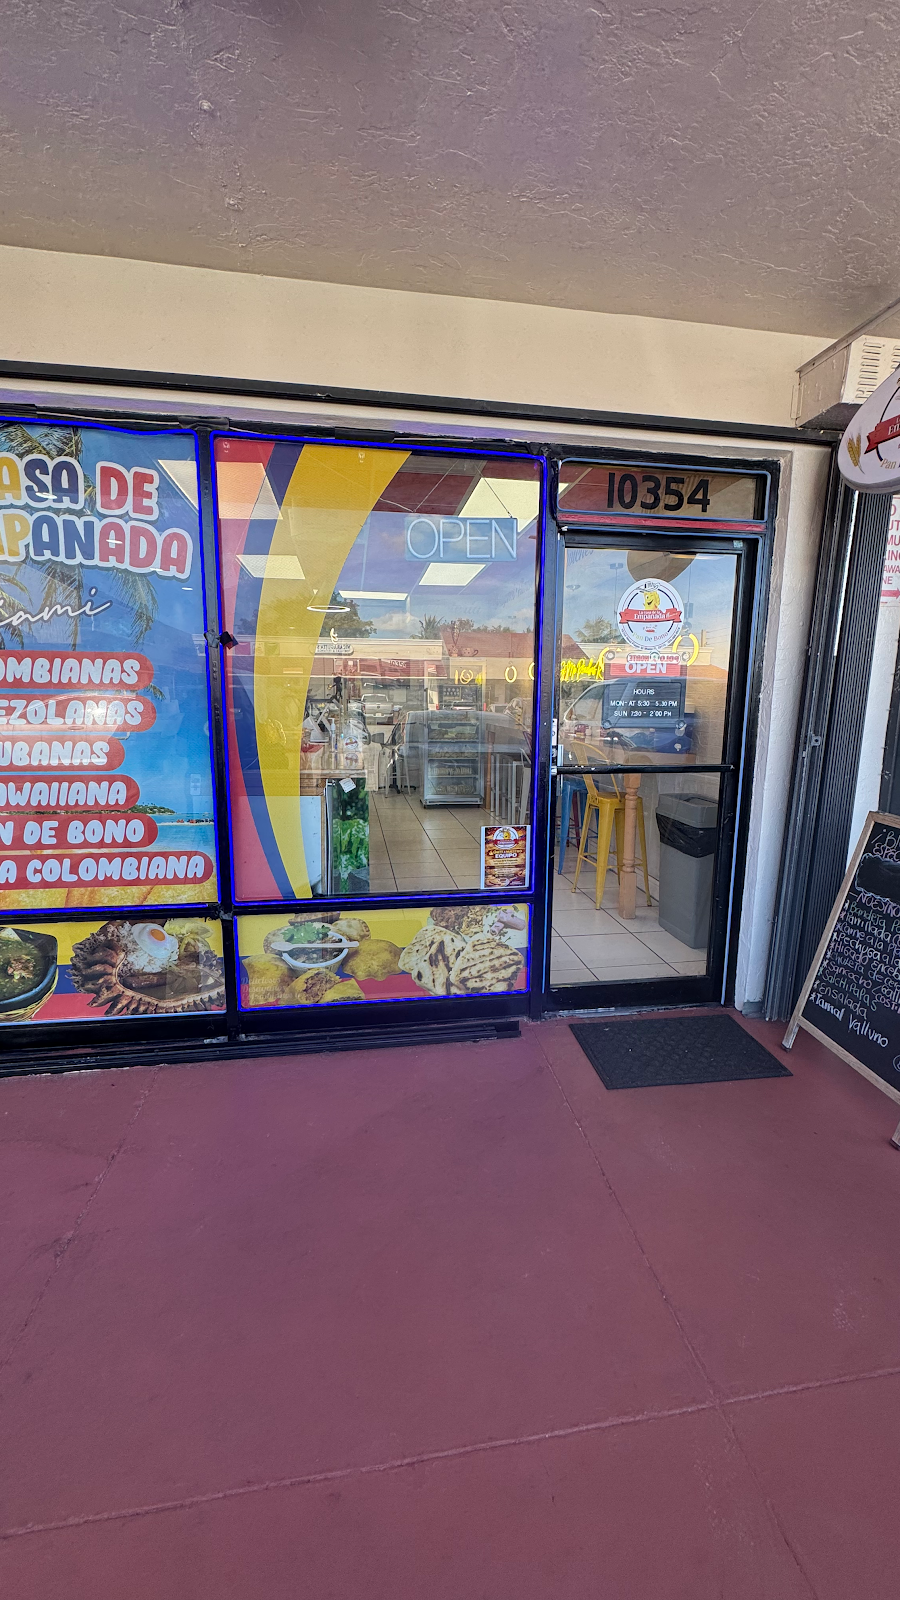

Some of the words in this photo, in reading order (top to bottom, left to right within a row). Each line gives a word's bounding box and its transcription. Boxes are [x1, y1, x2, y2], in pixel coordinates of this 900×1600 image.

[0, 455, 81, 506] ASA
[98, 464, 157, 518] DE
[606, 471, 711, 513] 10354
[0, 512, 189, 575] PANADA
[407, 518, 517, 559] OPEN
[634, 613, 666, 621] Empanada
[0, 657, 141, 685] MBIANAS
[625, 661, 667, 674] OPEN
[0, 781, 127, 806] WAIIANA
[23, 820, 59, 845] DE
[67, 818, 145, 844] BONO
[0, 859, 17, 884] A
[26, 855, 205, 883] COLOMBIANA
